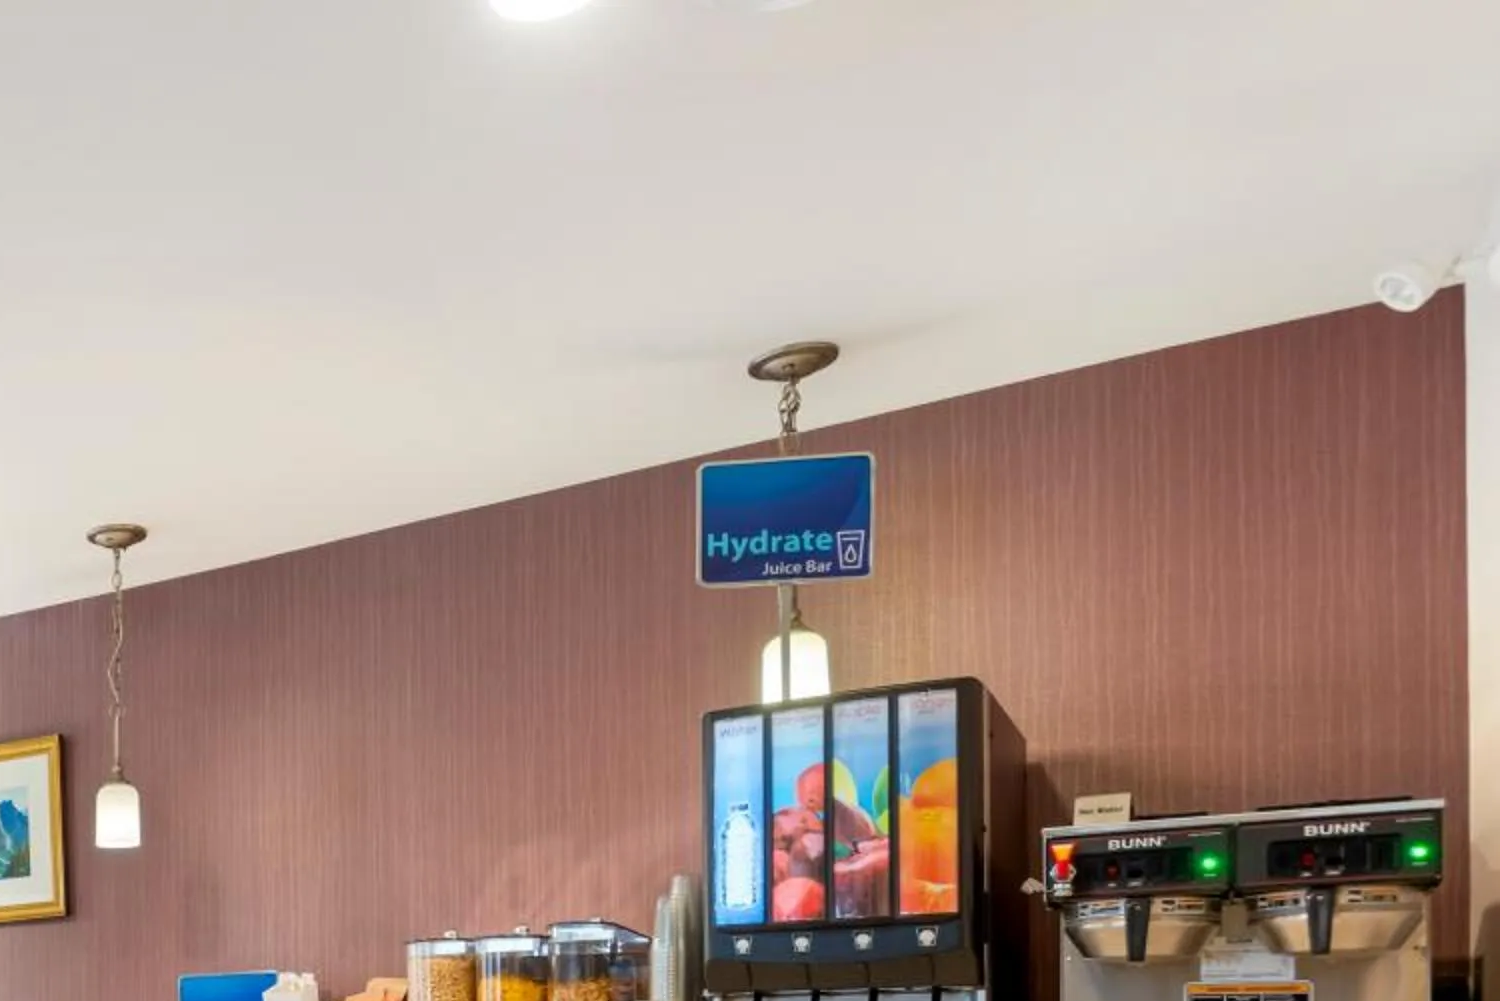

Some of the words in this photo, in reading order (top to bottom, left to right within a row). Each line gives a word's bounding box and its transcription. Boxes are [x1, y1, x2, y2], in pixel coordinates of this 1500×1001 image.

[707, 529, 833, 562] Hydrate
[762, 560, 802, 576] Juice
[805, 559, 833, 574] Bar
[1303, 822, 1366, 838] BUNN
[1108, 836, 1163, 851] BUNN
